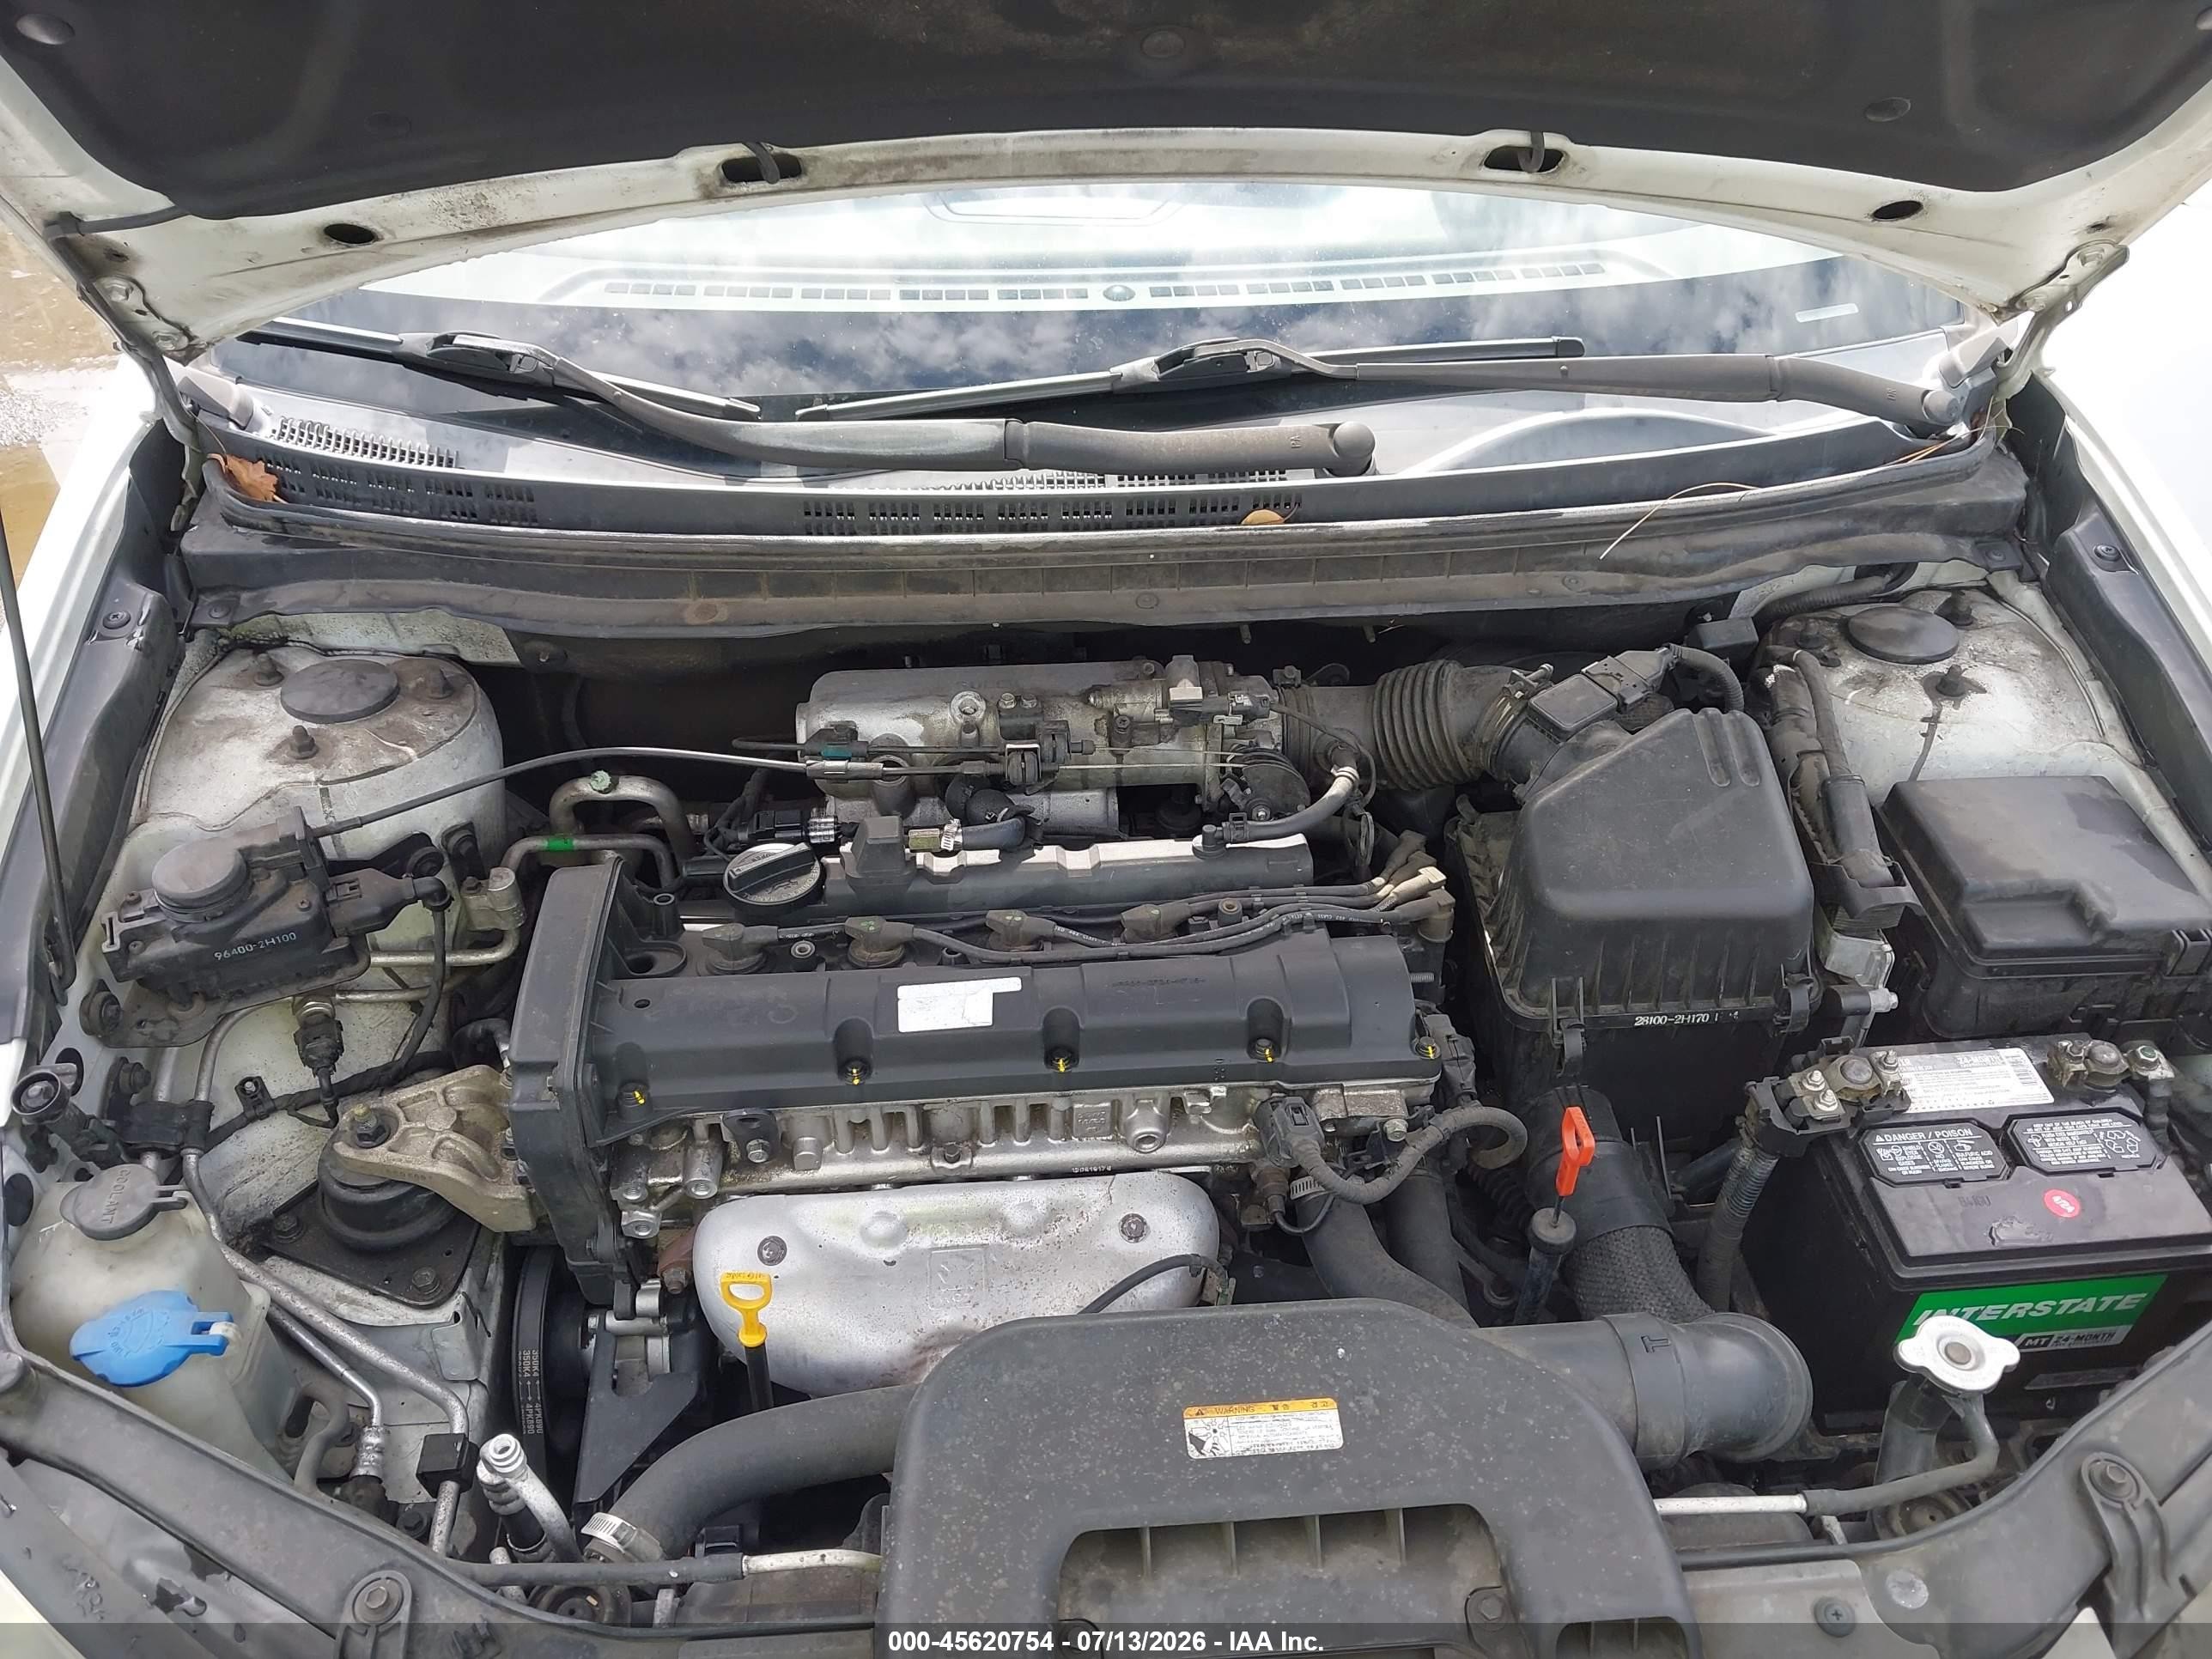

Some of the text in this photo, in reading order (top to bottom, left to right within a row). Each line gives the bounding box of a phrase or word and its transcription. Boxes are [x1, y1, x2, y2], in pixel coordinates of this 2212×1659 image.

[214, 932, 296, 961] 96400-2H100
[1634, 1012, 1710, 1026] 28100-2H170
[1884, 1132, 1926, 1142] DANGER
[1934, 1127, 1973, 1139] POISON
[100, 1169, 131, 1224] COOLANT
[2025, 1337, 2051, 1347] MT
[522, 1349, 532, 1378] 350K4
[1214, 1404, 1255, 1415] WARNING
